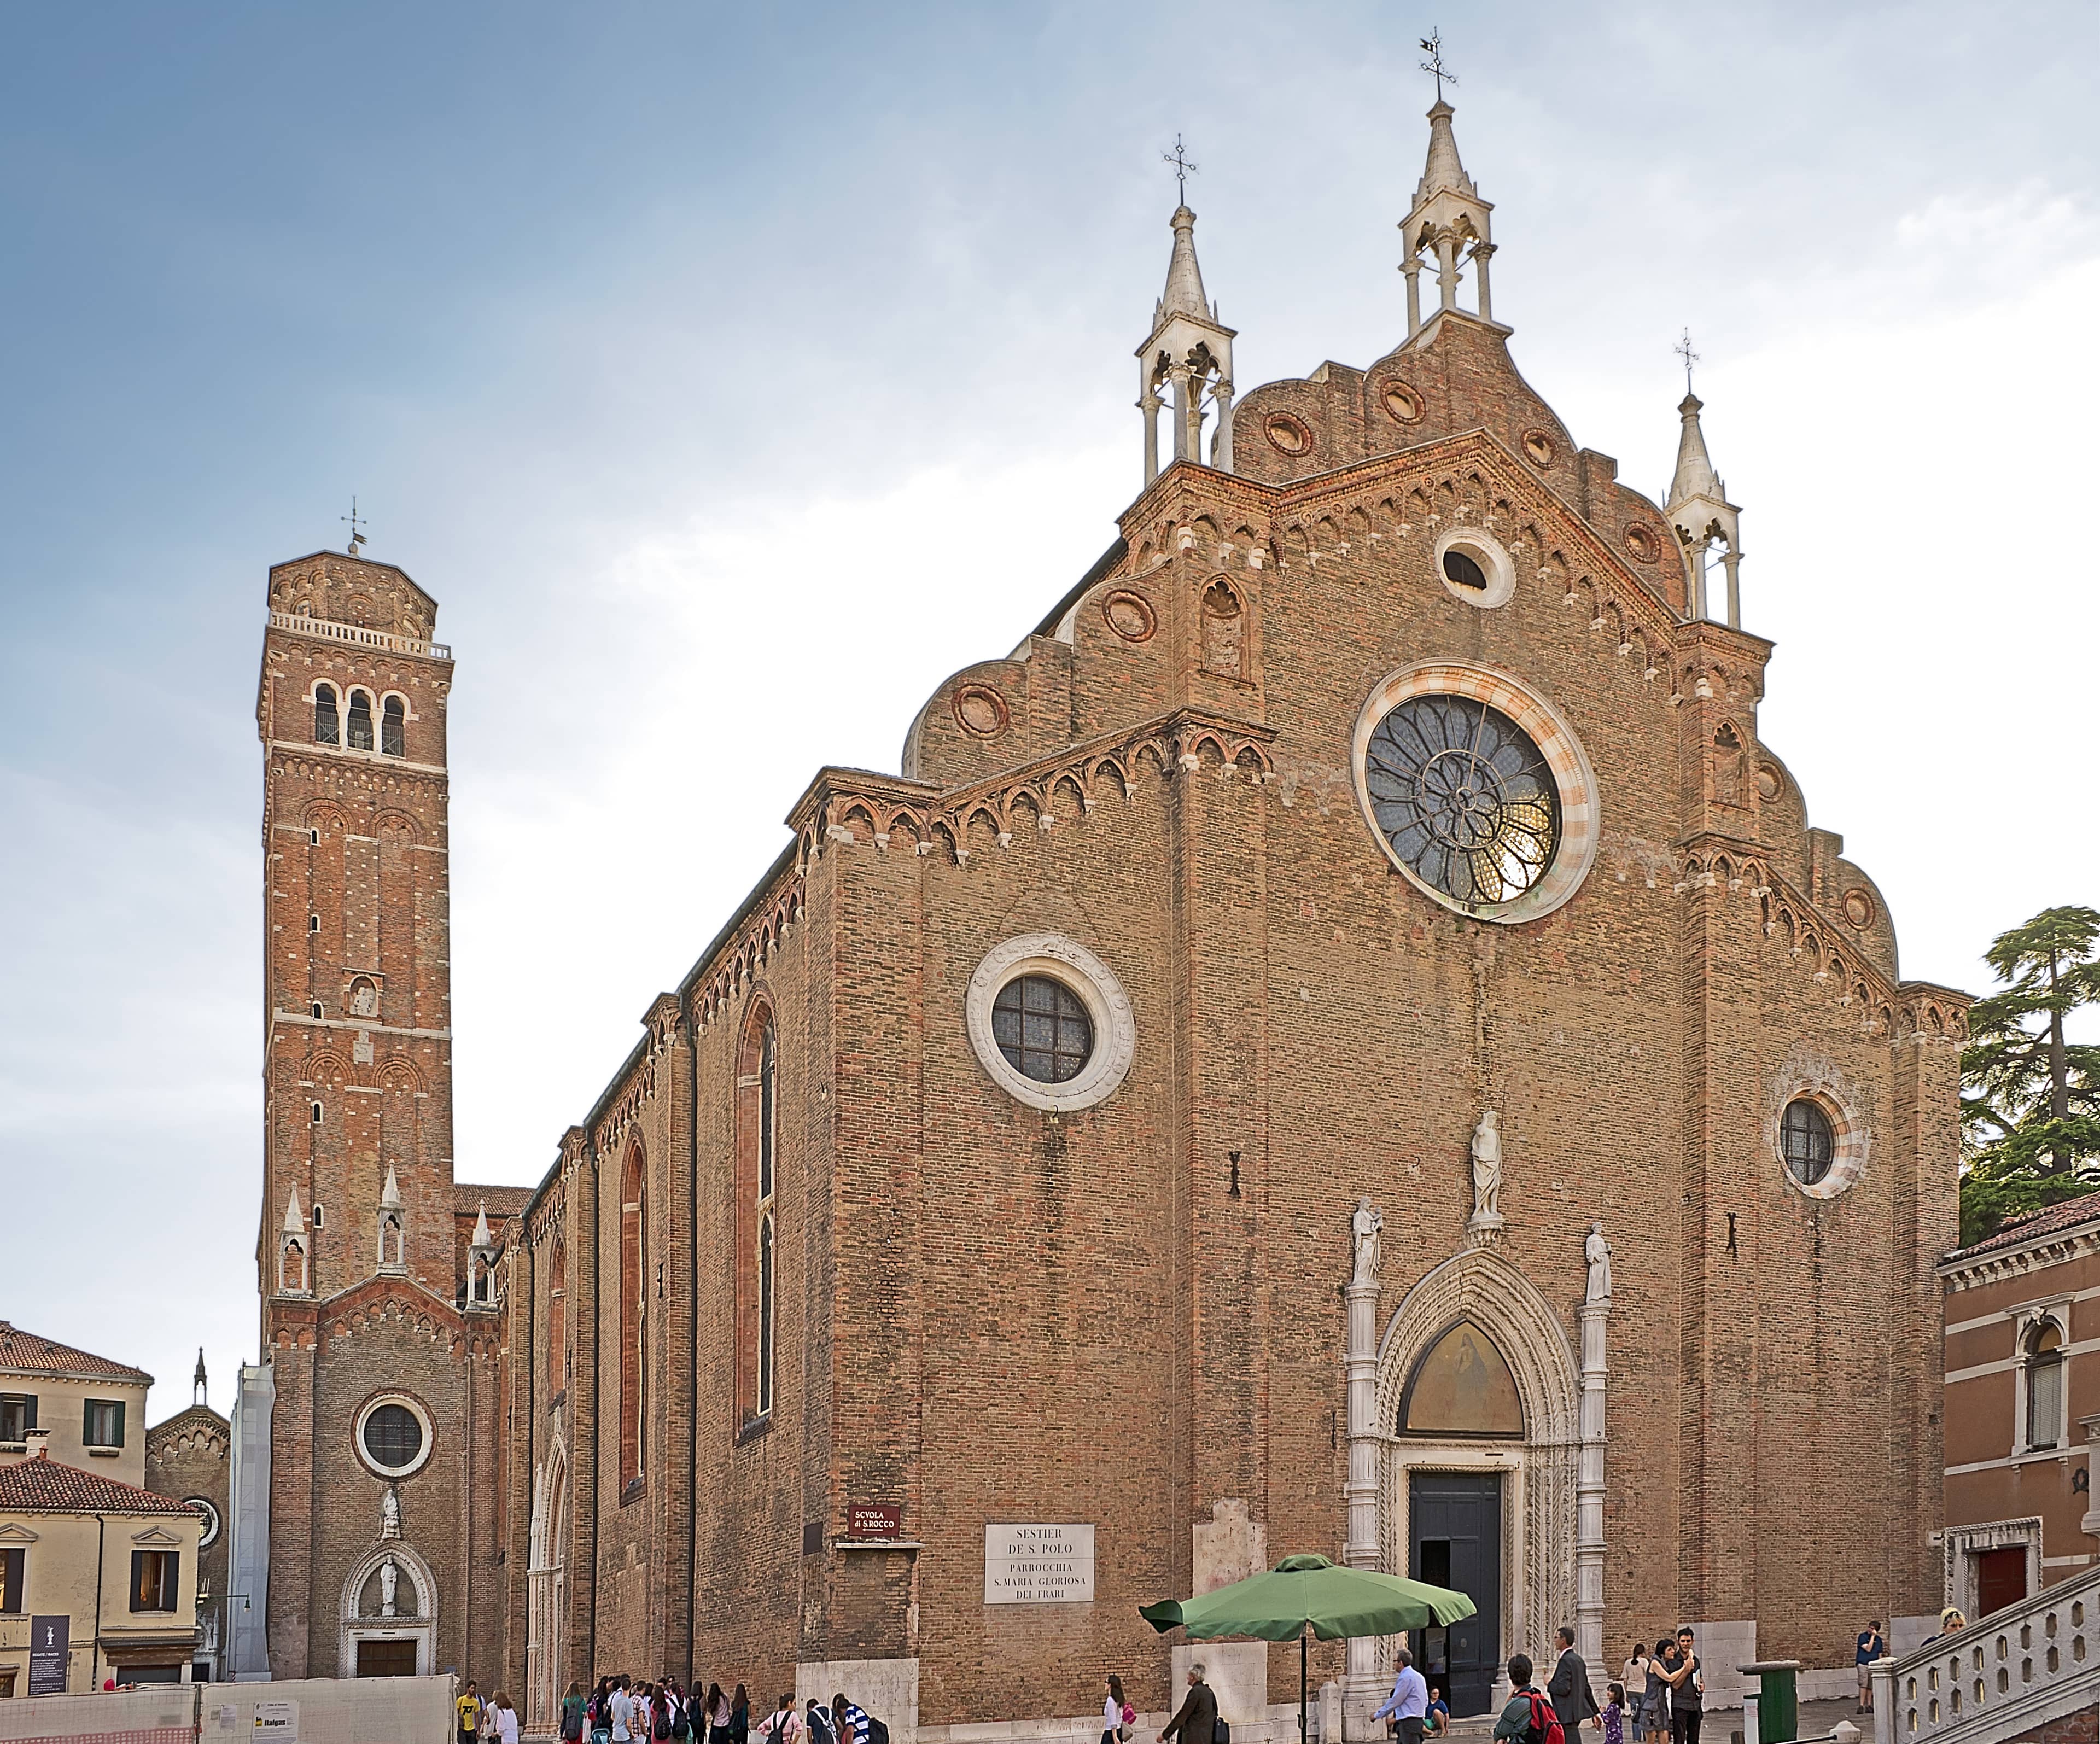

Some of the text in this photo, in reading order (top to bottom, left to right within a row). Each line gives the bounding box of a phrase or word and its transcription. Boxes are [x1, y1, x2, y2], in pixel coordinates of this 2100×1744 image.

[1016, 1529, 1062, 1539] SESTIER
[1008, 1544, 1072, 1554] DE S. POLO
[1010, 1564, 1072, 1572] PARROCCHIA
[994, 1577, 1086, 1586] S. MARIA GLORIOSA
[1016, 1590, 1064, 1599] DEI FRARI
